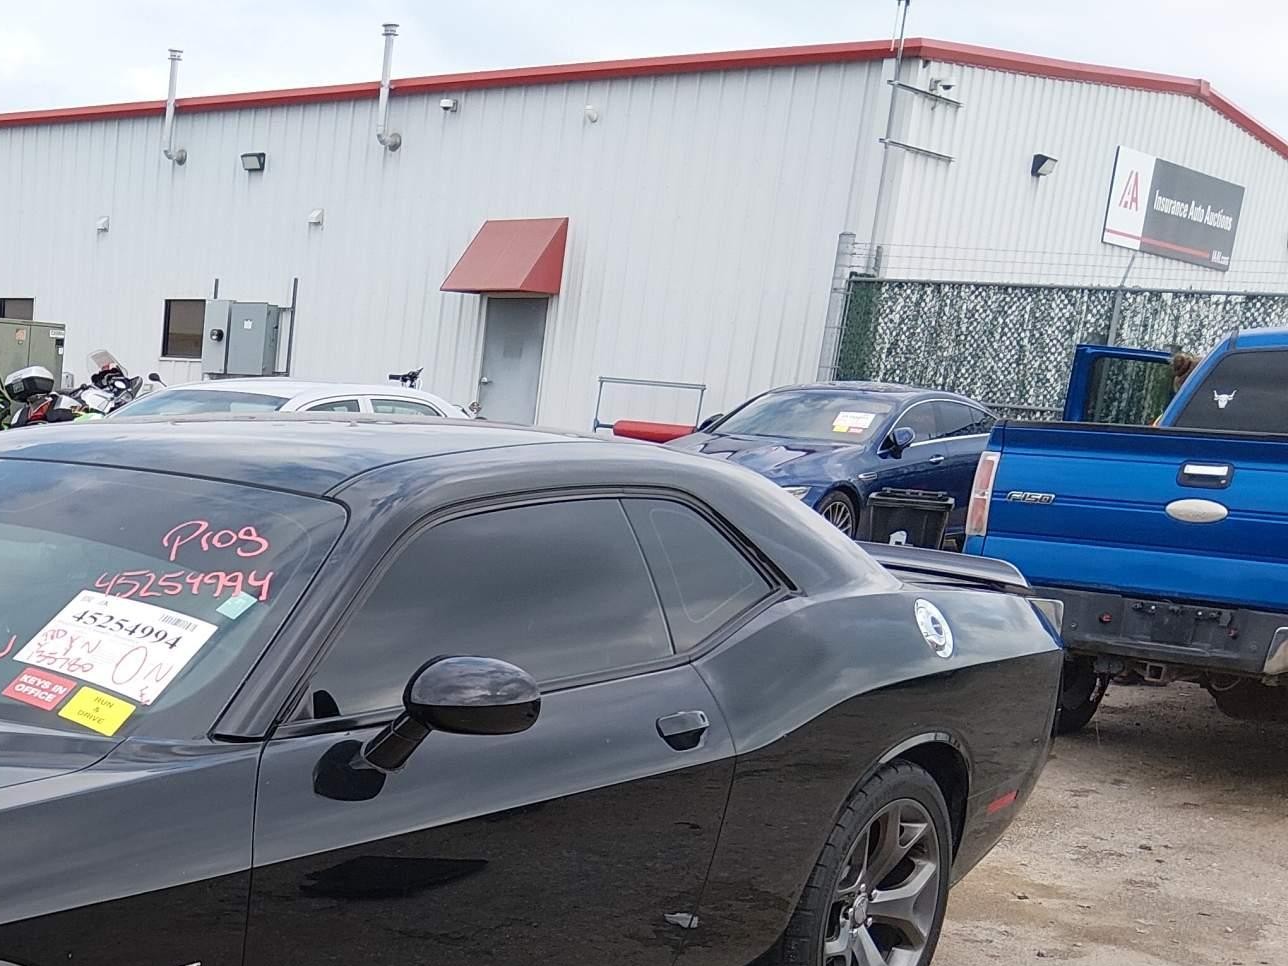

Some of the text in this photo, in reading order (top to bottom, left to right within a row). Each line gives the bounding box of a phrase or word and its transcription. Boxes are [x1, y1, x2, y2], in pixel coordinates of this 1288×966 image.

[1153, 189, 1232, 231] Insurance Auto Auctions
[94, 569, 274, 601] 45254994
[72, 608, 183, 650] 45254994
[14, 683, 56, 703] OFFICE
[19, 674, 68, 695] KEYS IN
[94, 696, 115, 709] RUN
[77, 709, 105, 725] DRIVE
